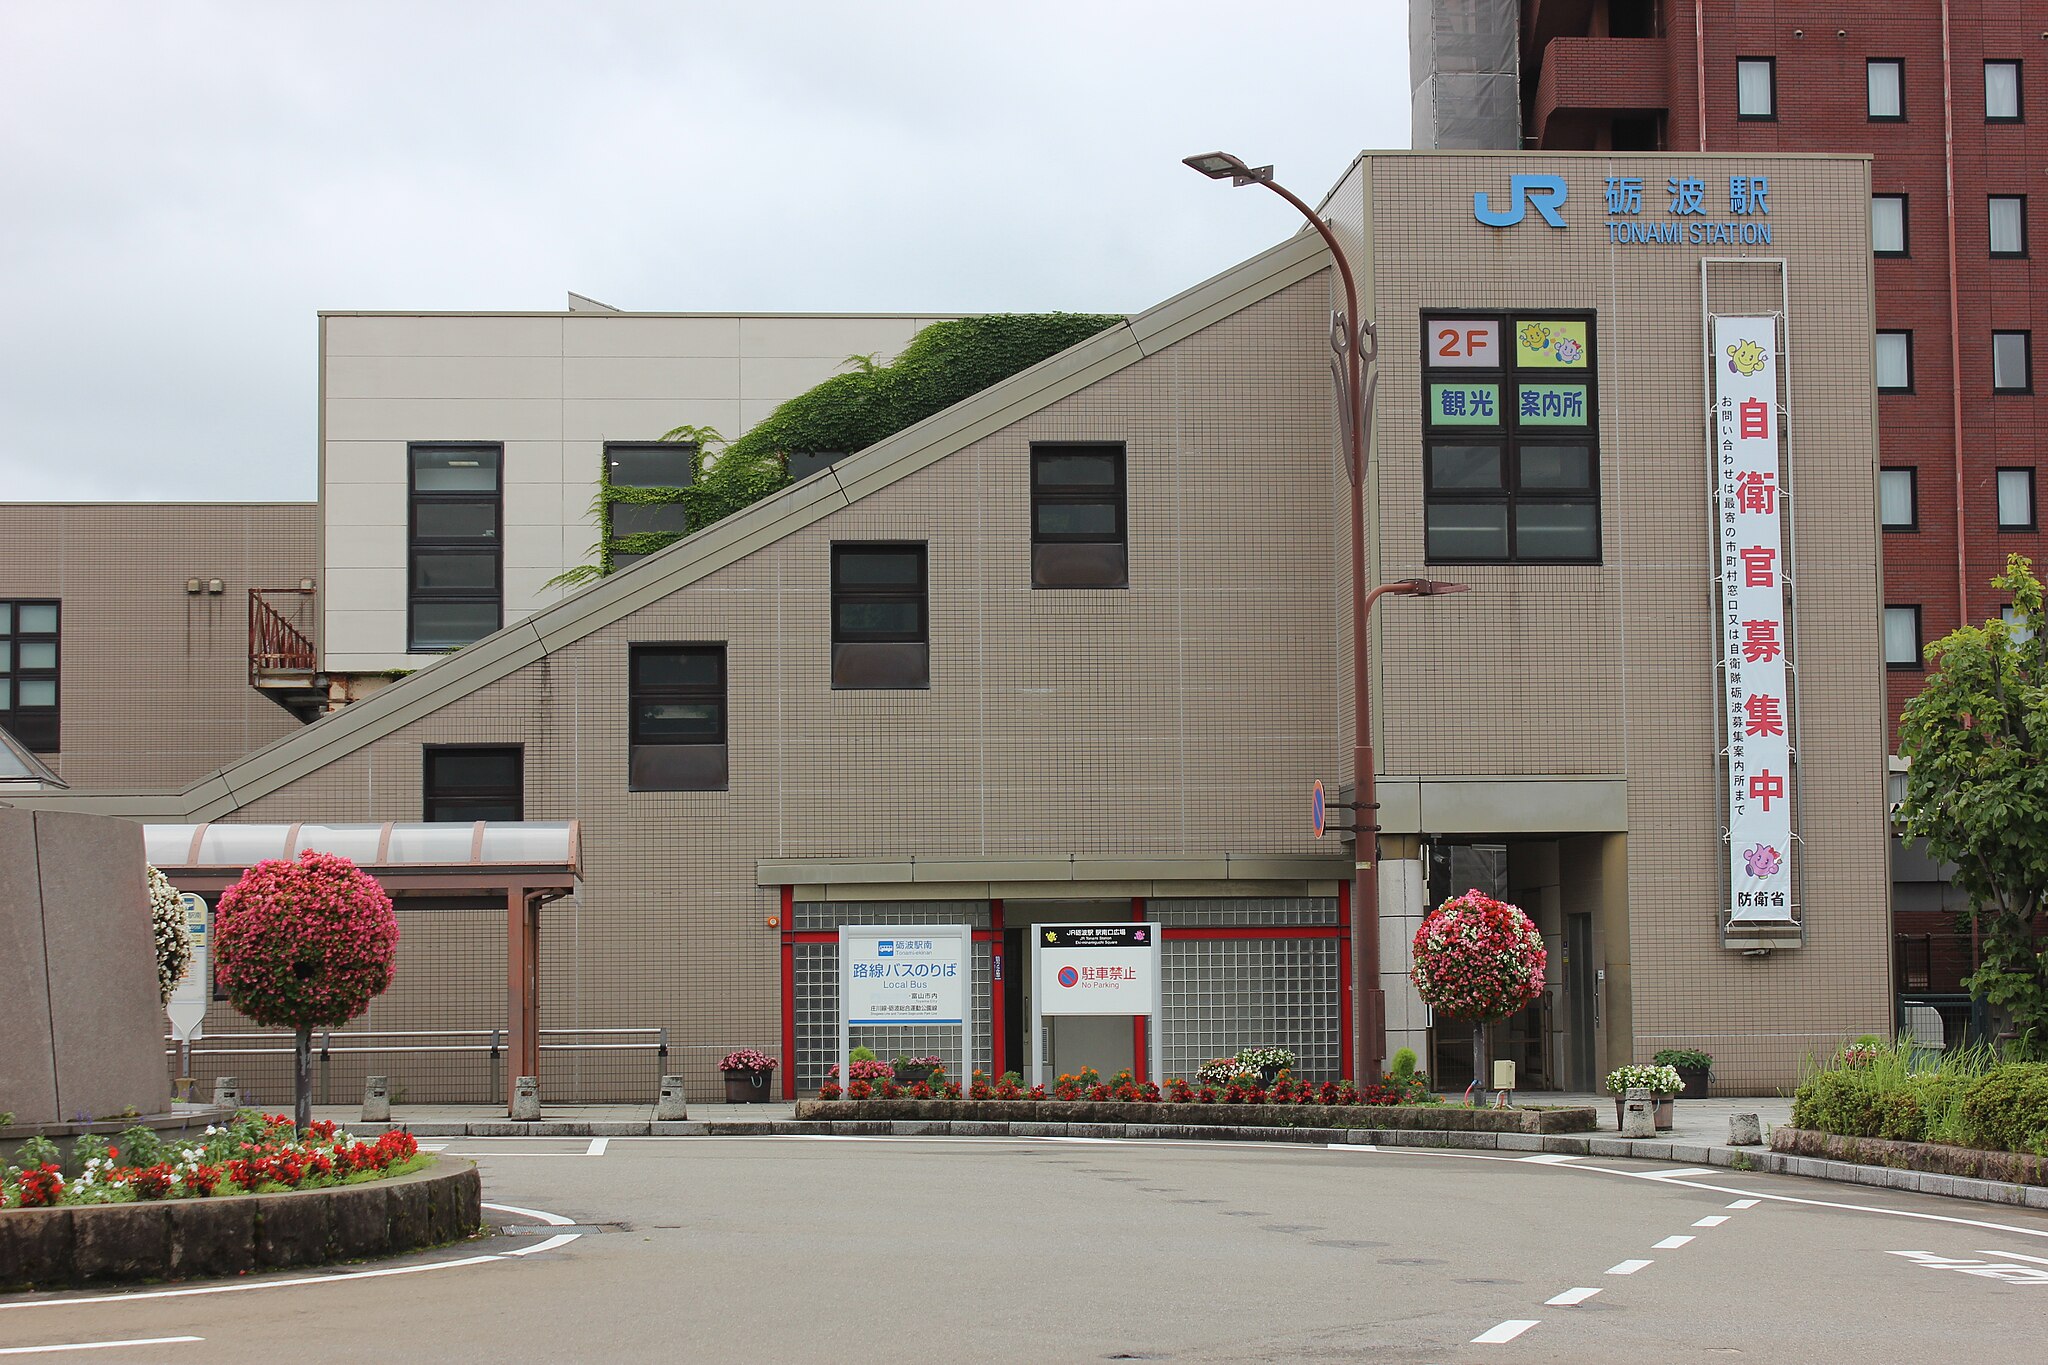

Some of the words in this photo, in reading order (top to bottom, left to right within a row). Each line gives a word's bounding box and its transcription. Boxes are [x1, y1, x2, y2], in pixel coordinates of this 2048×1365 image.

[1474, 174, 1567, 227] JR
[1605, 176, 1769, 215] 砺波駅
[1605, 222, 1682, 243] TONAMI
[1689, 222, 1771, 244] STATION
[1438, 329, 1489, 357] 2F
[1441, 389, 1494, 417] 観光
[1521, 391, 1583, 418] 案内所
[1736, 397, 1784, 811] 自衛官募集中
[1738, 891, 1784, 907] 防衛省
[896, 940, 932, 949] 砺波駅南
[853, 963, 957, 978] 路線バスのりば
[1082, 967, 1136, 980] 駐車禁止
[883, 980, 908, 989] Local
[910, 980, 927, 989] Bus
